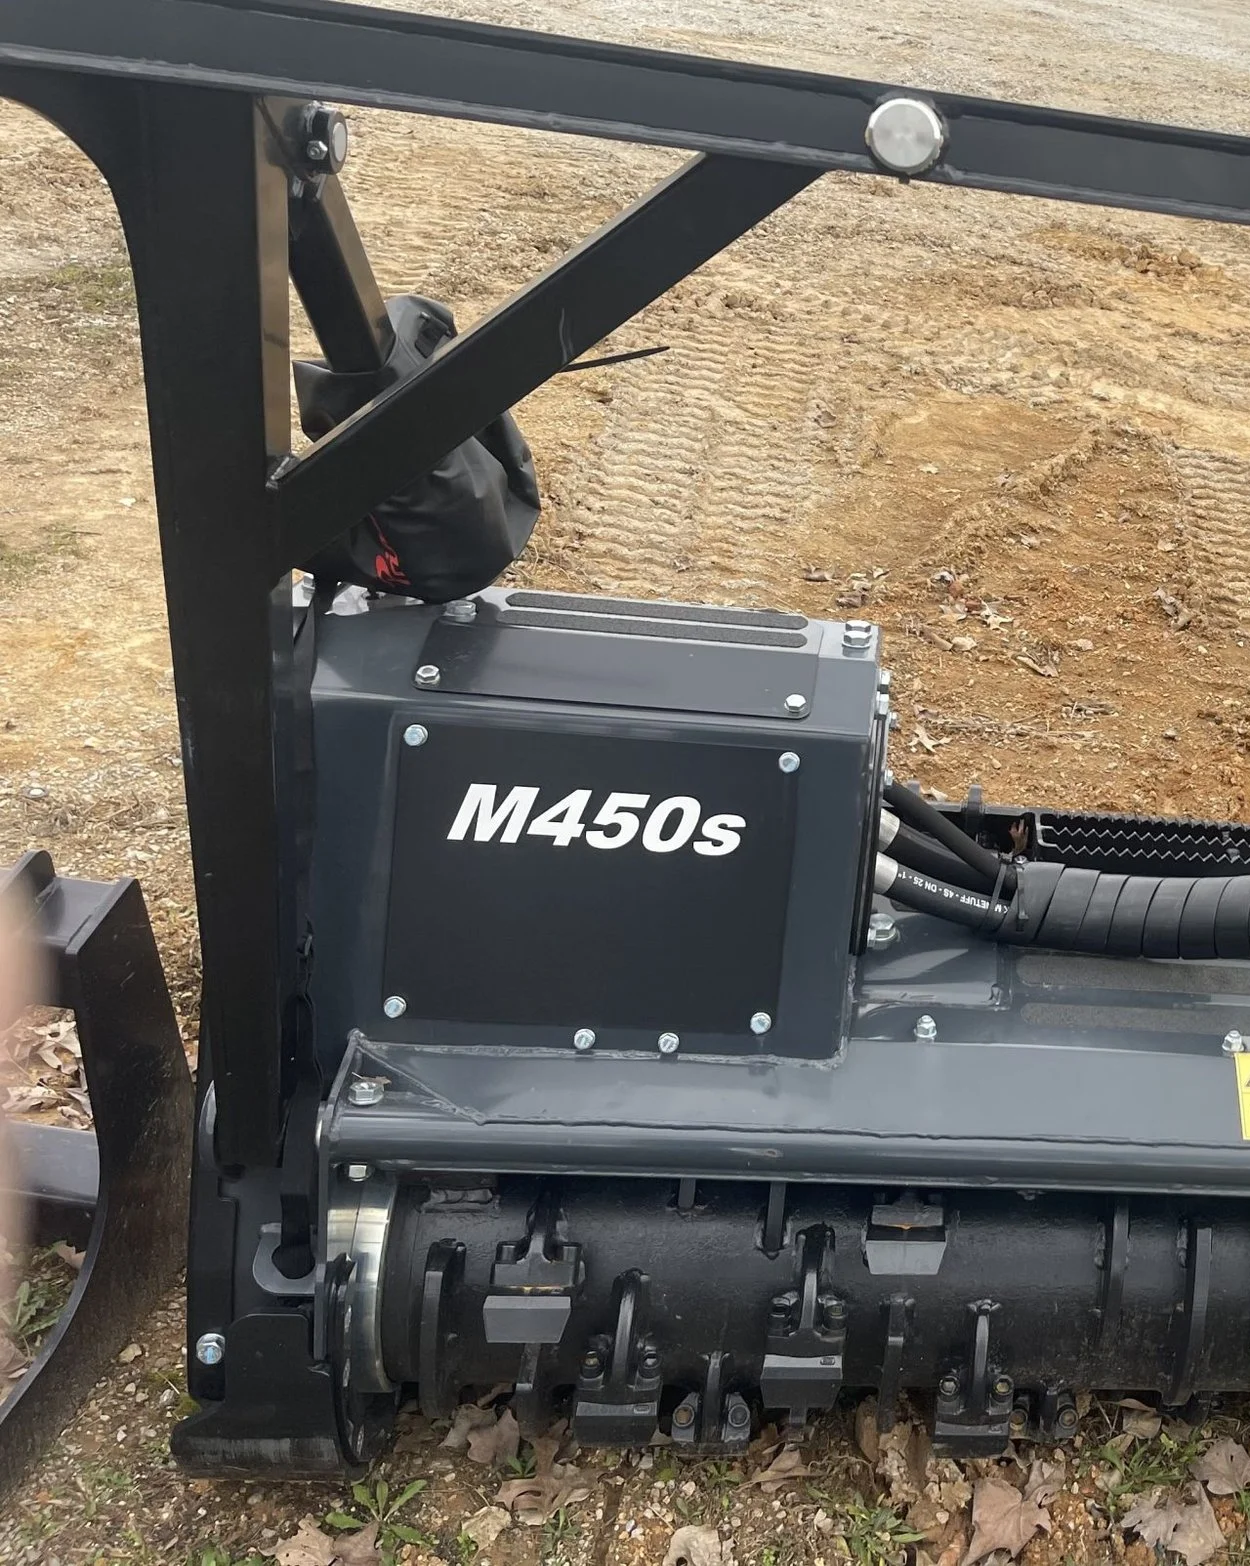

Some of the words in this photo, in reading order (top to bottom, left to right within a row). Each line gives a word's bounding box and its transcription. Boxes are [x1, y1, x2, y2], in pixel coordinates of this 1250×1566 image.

[445, 783, 747, 857] M450s
[913, 876, 924, 887] 25
[924, 881, 937, 893] DN
[960, 896, 1002, 912] MNETUFF
